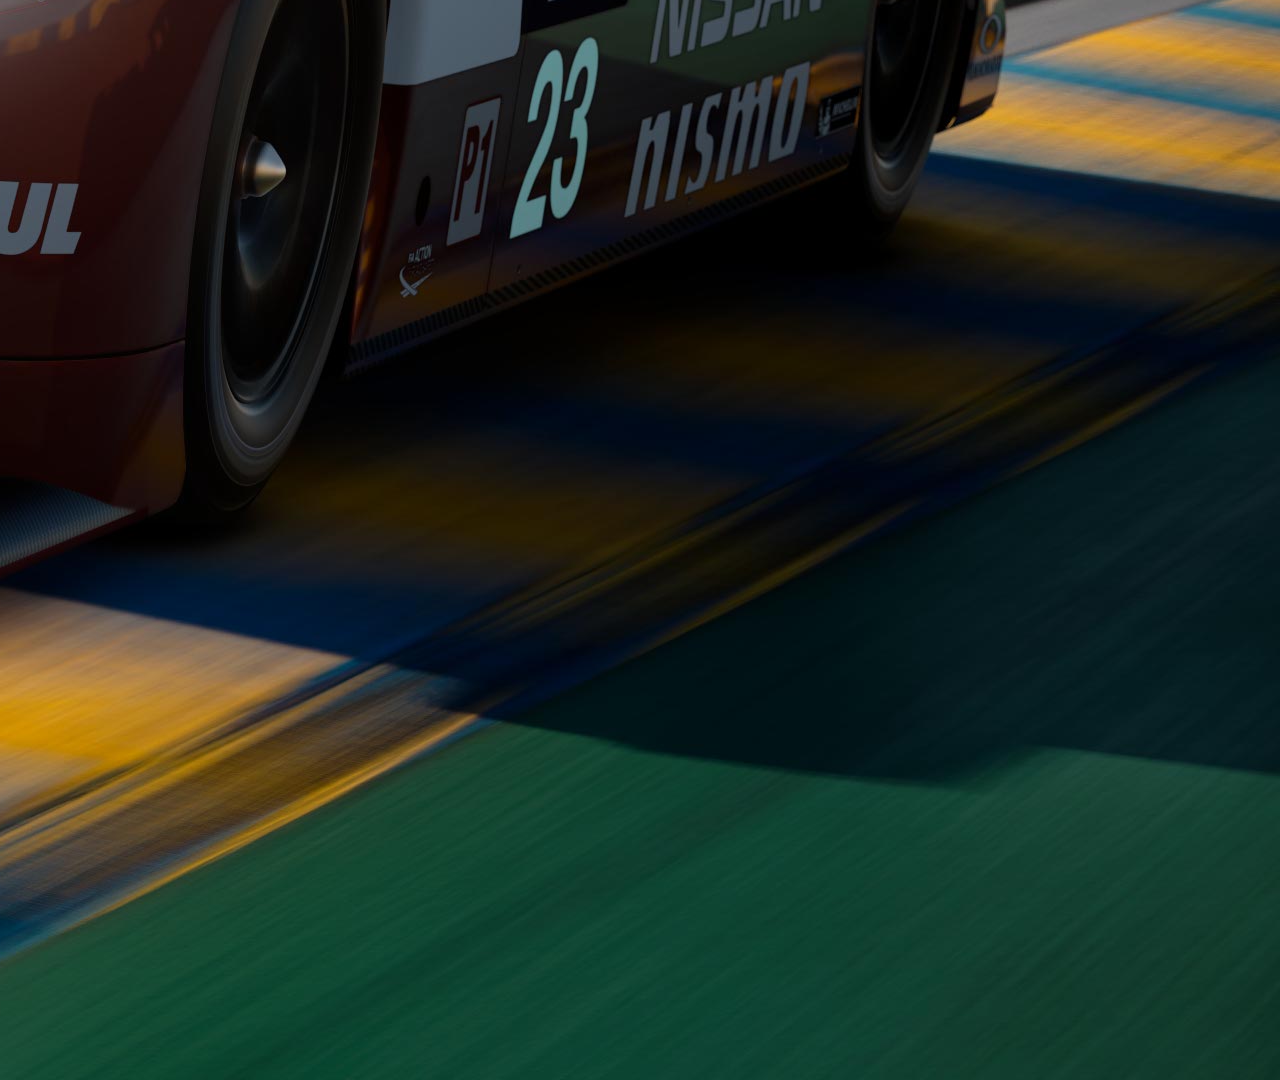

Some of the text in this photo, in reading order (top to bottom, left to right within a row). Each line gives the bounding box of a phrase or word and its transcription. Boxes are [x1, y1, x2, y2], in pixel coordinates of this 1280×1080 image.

[453, 118, 492, 222] P1
[509, 37, 599, 239] 23
[624, 61, 811, 218] nismo
